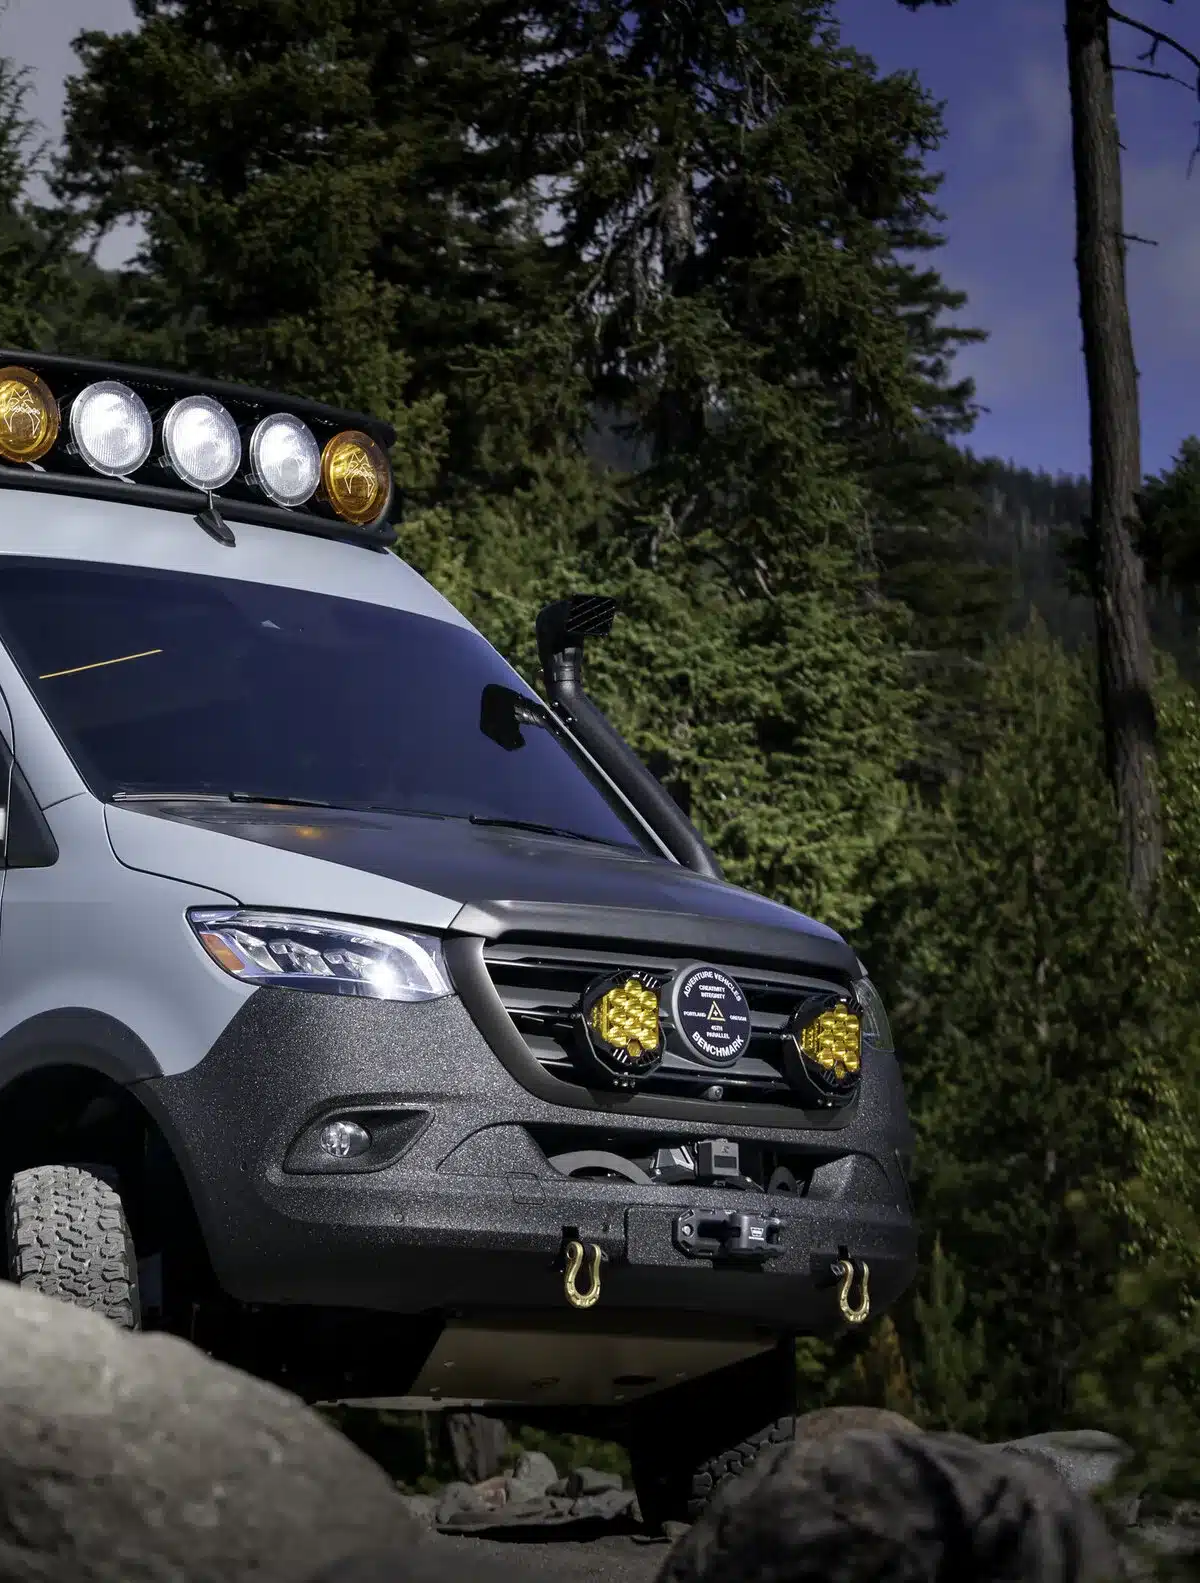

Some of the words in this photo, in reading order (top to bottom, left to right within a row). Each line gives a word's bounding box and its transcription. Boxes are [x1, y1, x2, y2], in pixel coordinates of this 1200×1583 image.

[683, 971, 713, 998] ADVENTURE
[714, 972, 742, 1002] VEHICLES
[698, 985, 726, 993] CREATIVITY
[700, 992, 726, 1000] INTEGRITY
[683, 1010, 707, 1018] PORTLAND
[706, 1031, 731, 1040] PARALLEL
[692, 1031, 744, 1058] BENCHMARK
